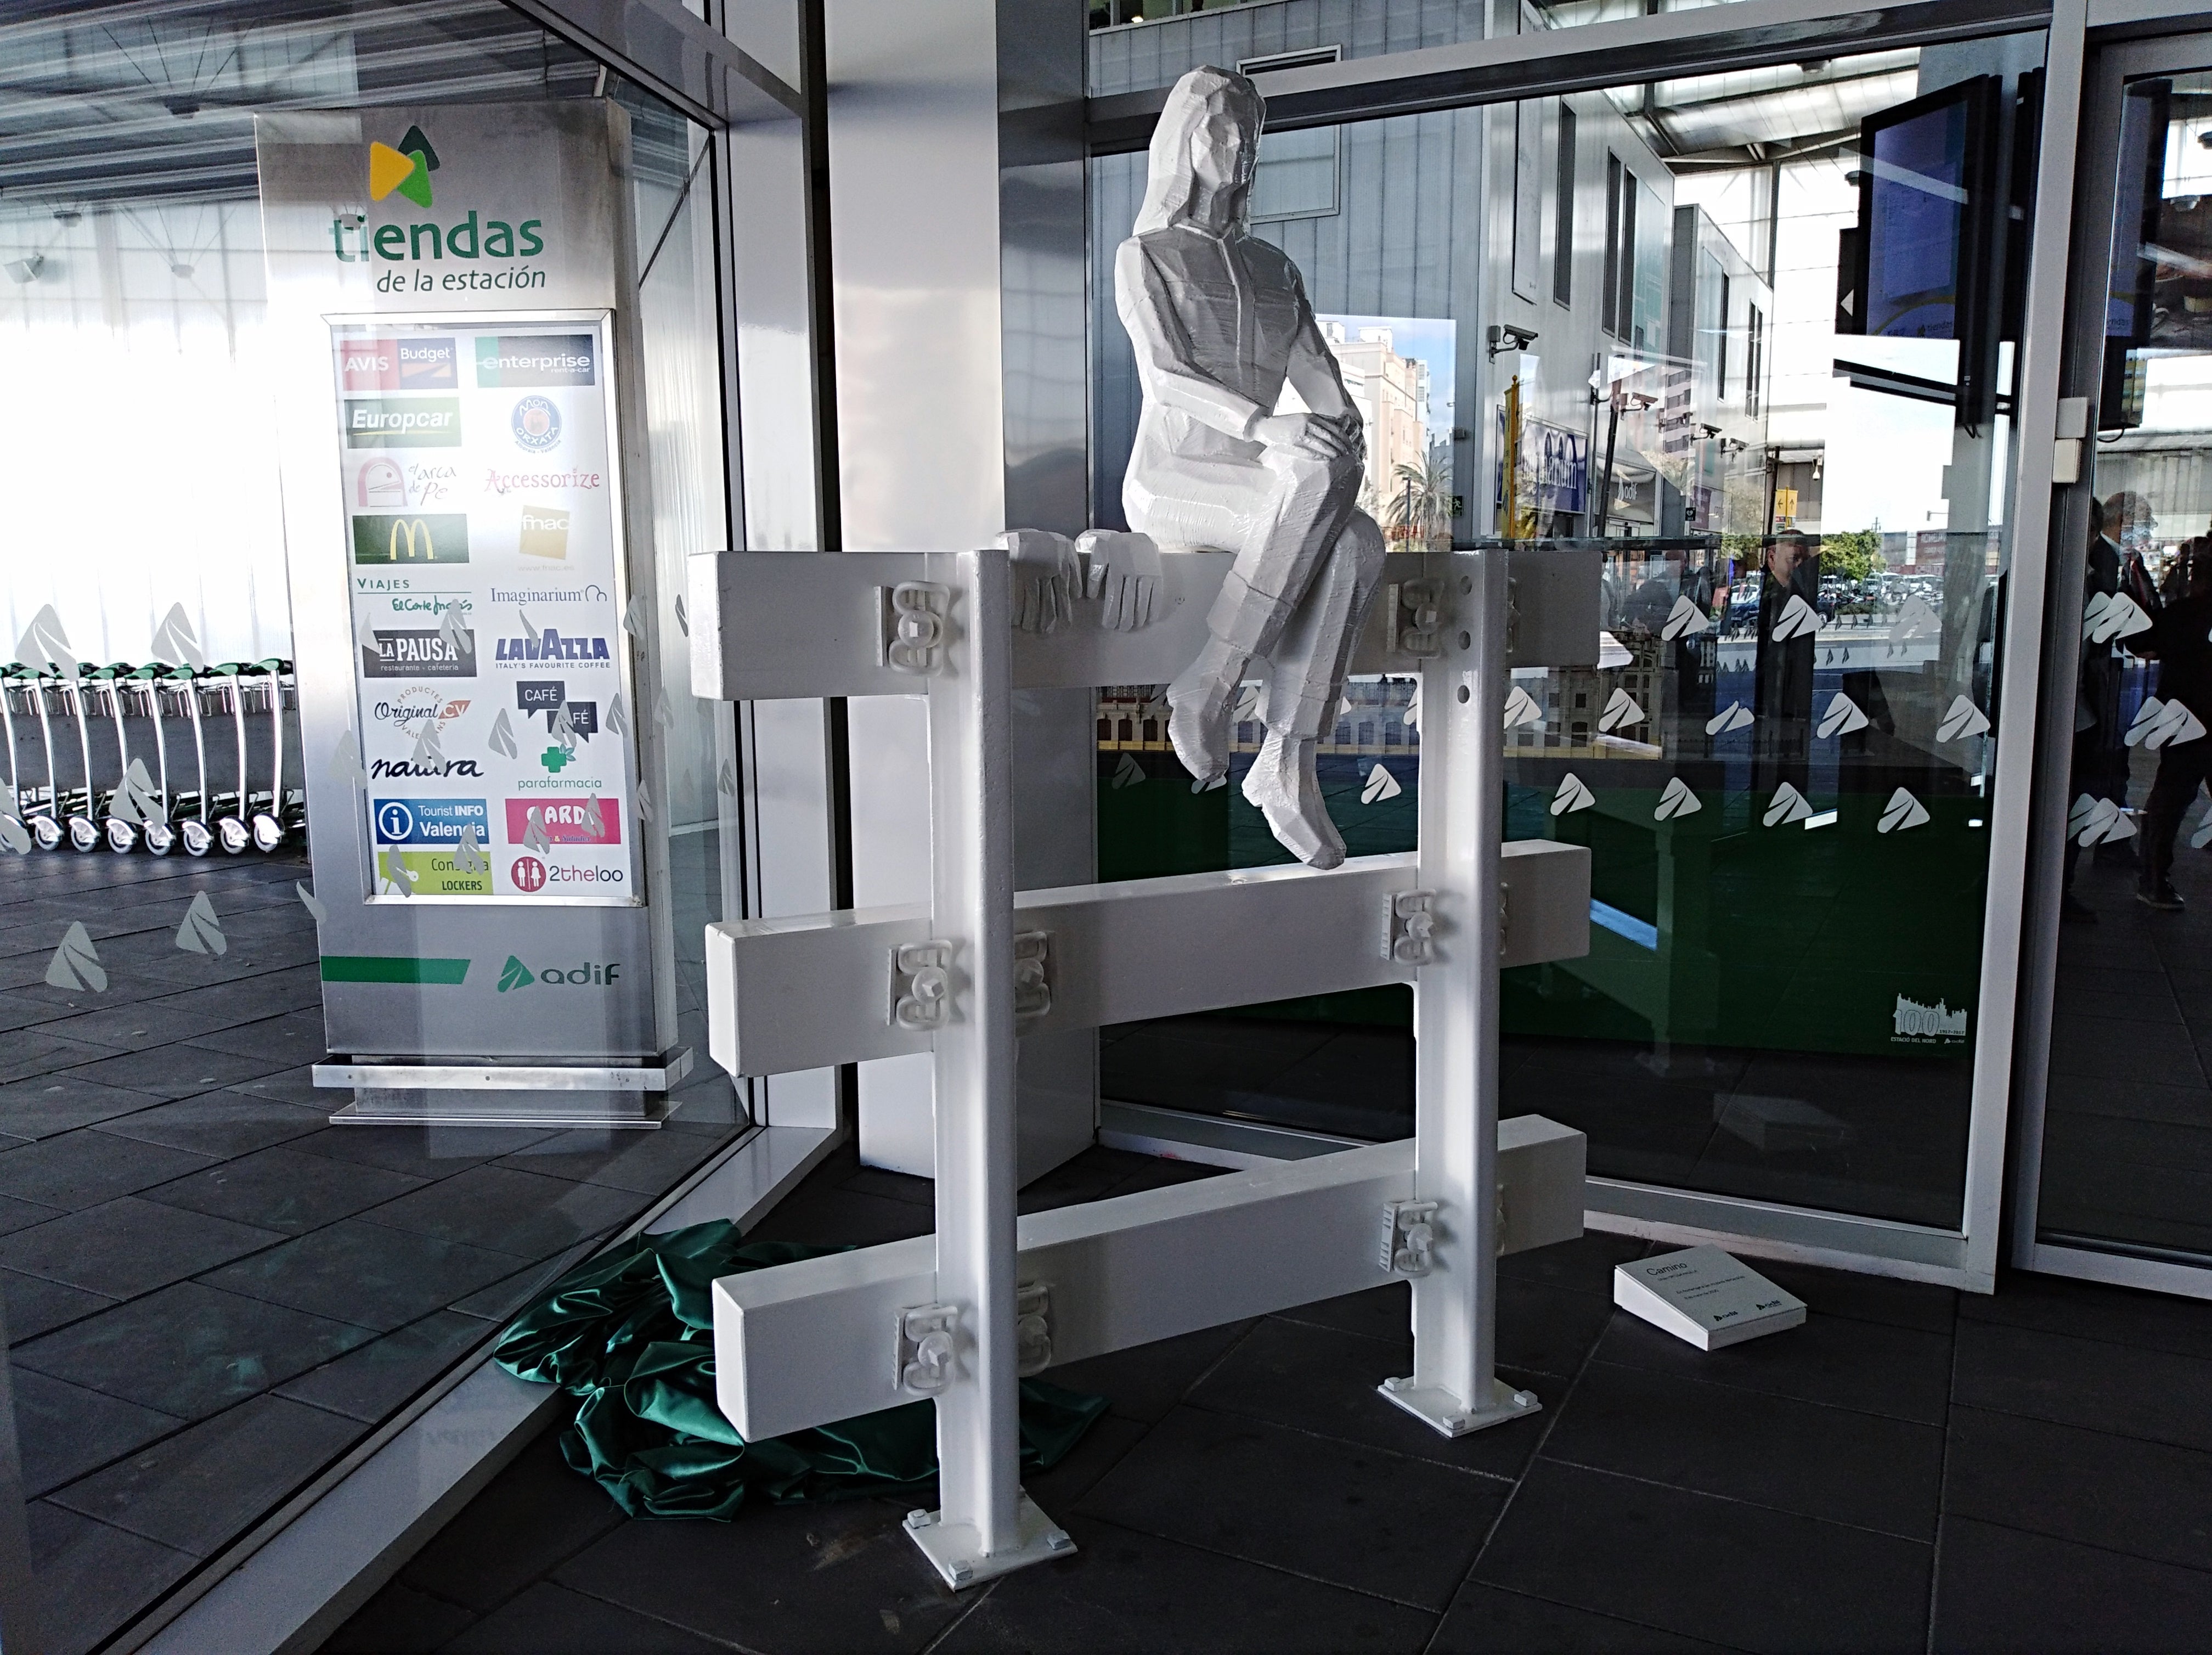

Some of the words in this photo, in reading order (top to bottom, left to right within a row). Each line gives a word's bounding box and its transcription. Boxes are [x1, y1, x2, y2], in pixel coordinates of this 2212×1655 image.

[328, 210, 544, 262] tiendas
[376, 269, 405, 293] de
[414, 269, 433, 291] la
[442, 265, 545, 290] estación
[400, 347, 451, 362] Budget
[479, 353, 591, 371] enterprise
[344, 357, 390, 372] AVIS
[352, 409, 453, 434] Europcar
[516, 427, 558, 445] ORXATA
[408, 463, 419, 475] el
[417, 466, 456, 480] arca
[484, 466, 600, 493] Accessorize
[409, 481, 421, 493] de
[522, 514, 569, 531] fnac
[357, 578, 410, 590] VIAJES
[392, 598, 404, 611] El
[404, 599, 432, 611] Corte
[490, 587, 582, 605] Imaginarium
[379, 643, 395, 657] LA
[396, 638, 459, 661] PAUSA
[495, 628, 610, 660] LAVAZZA
[397, 686, 443, 704] PRODUCTES
[524, 685, 558, 701] CAFÉ
[375, 702, 438, 727] Original
[443, 704, 465, 717] CV
[518, 776, 602, 790] parafarmacia
[417, 805, 453, 817] Tourist
[454, 804, 484, 816] INFO
[526, 805, 595, 825] ARD
[549, 865, 623, 882] 2theloo
[442, 880, 483, 891] LOCKERS
[541, 962, 621, 986] adif
[1893, 1009, 1940, 1037] 100
[1646, 1263, 1688, 1275] Camino
